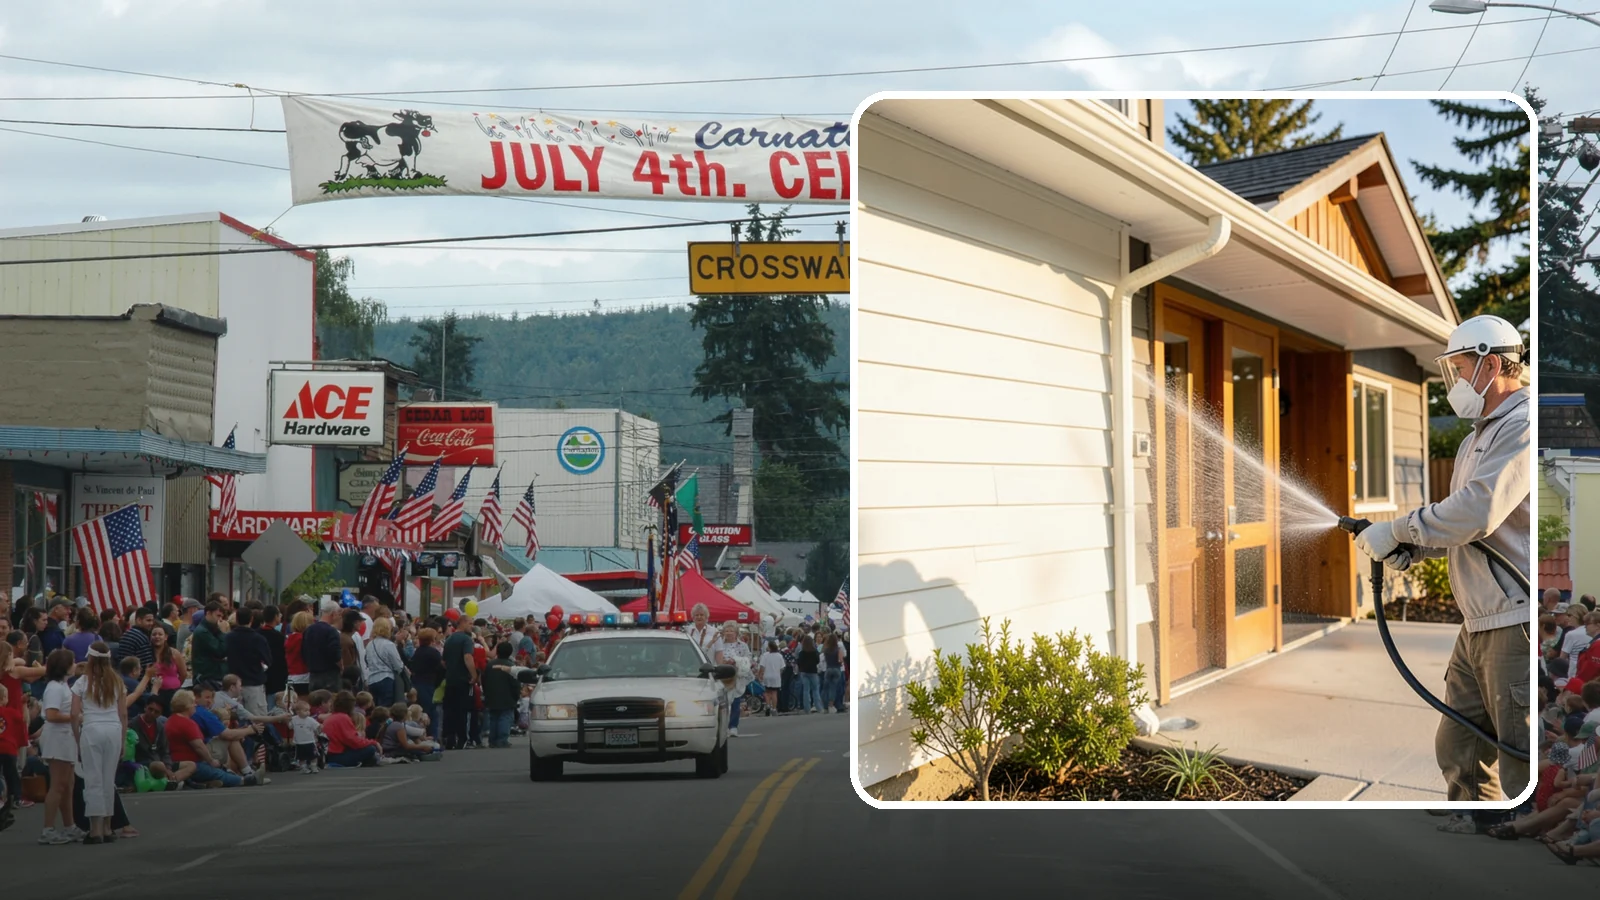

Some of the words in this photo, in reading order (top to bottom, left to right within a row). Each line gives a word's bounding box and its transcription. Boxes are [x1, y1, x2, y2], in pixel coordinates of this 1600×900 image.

[481, 141, 604, 192] JULY
[632, 150, 746, 198] 4th.
[697, 254, 850, 280] CROSSWA
[282, 380, 373, 420] ACE
[405, 409, 452, 422] CEDAR
[283, 421, 370, 436] Hardware
[416, 428, 477, 447] Coca-Cola
[353, 467, 385, 480] Simpl
[95, 485, 124, 495] Vincent
[126, 486, 136, 495] de
[137, 486, 155, 495] Paul
[81, 503, 153, 522] THT
[688, 526, 741, 535] CRNATION
[699, 535, 730, 543] GLASS
